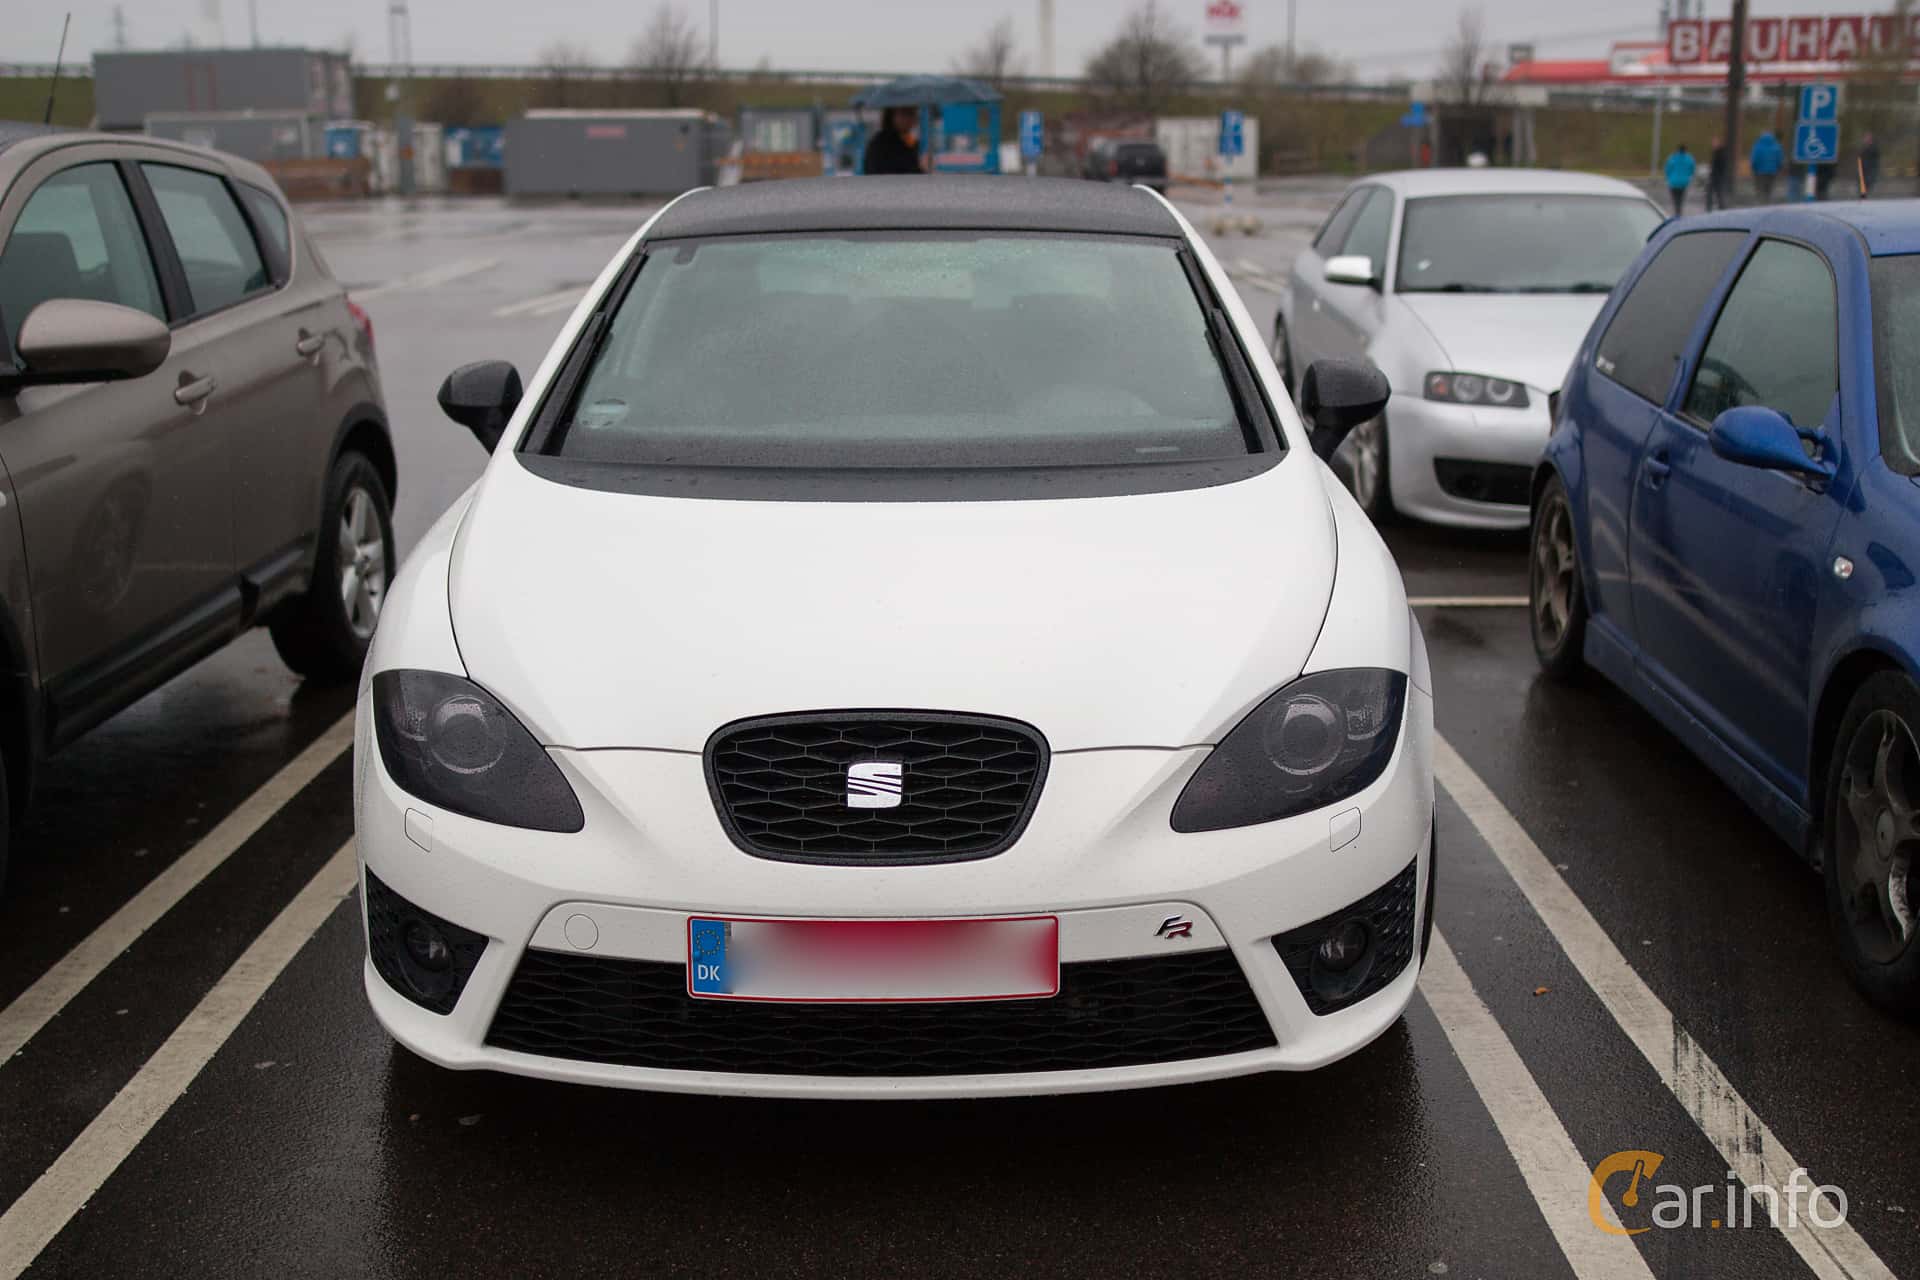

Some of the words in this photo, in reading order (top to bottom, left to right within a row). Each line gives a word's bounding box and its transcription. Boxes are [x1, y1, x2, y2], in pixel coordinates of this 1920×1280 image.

[1672, 20, 1920, 60] BAUHAU
[1811, 88, 1831, 118] P
[1153, 914, 1193, 940] FR
[697, 964, 721, 982] DK
